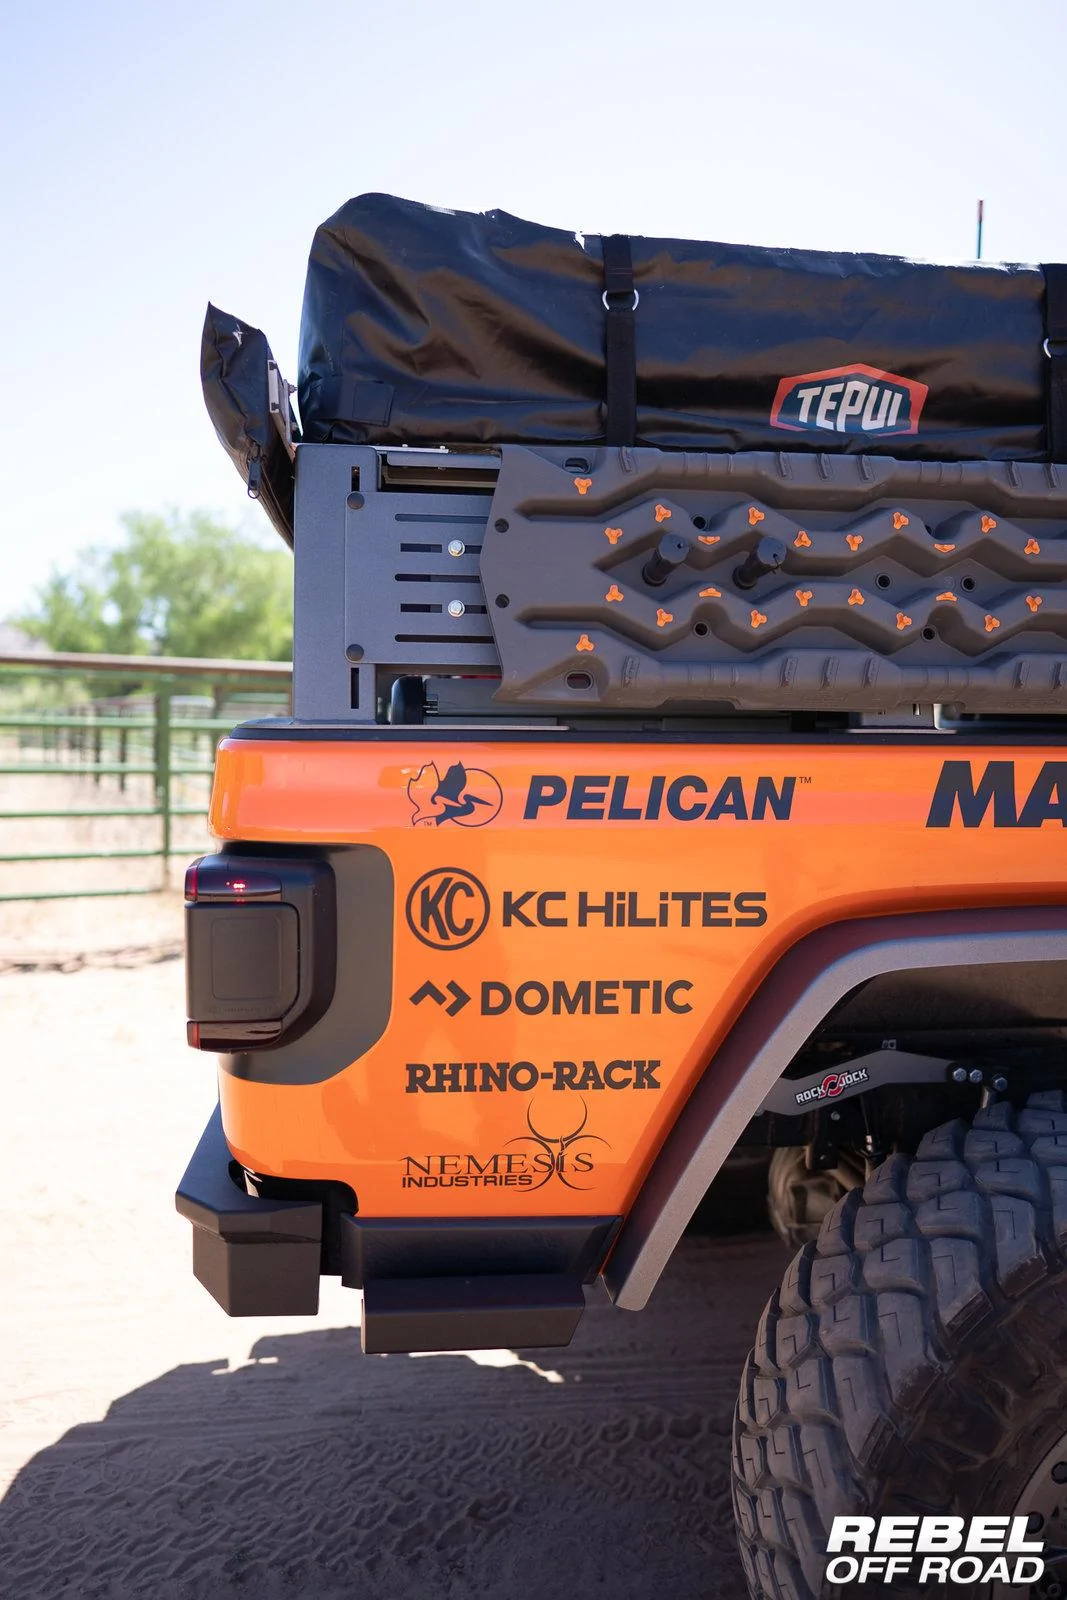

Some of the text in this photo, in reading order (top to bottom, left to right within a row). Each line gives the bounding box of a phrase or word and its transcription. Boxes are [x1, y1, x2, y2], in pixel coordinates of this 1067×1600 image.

[797, 380, 903, 433] TEPUI
[522, 775, 797, 820] PELICAN
[925, 760, 1067, 828] MA
[419, 876, 476, 941] KC
[502, 891, 567, 928] KC
[480, 979, 694, 1016] DOMETIC
[404, 1059, 661, 1093] RHINO-RACK
[795, 1068, 868, 1104] ROCK JOCK
[399, 1151, 594, 1175] NEMESIS
[401, 1174, 533, 1188] INDUSTRIES
